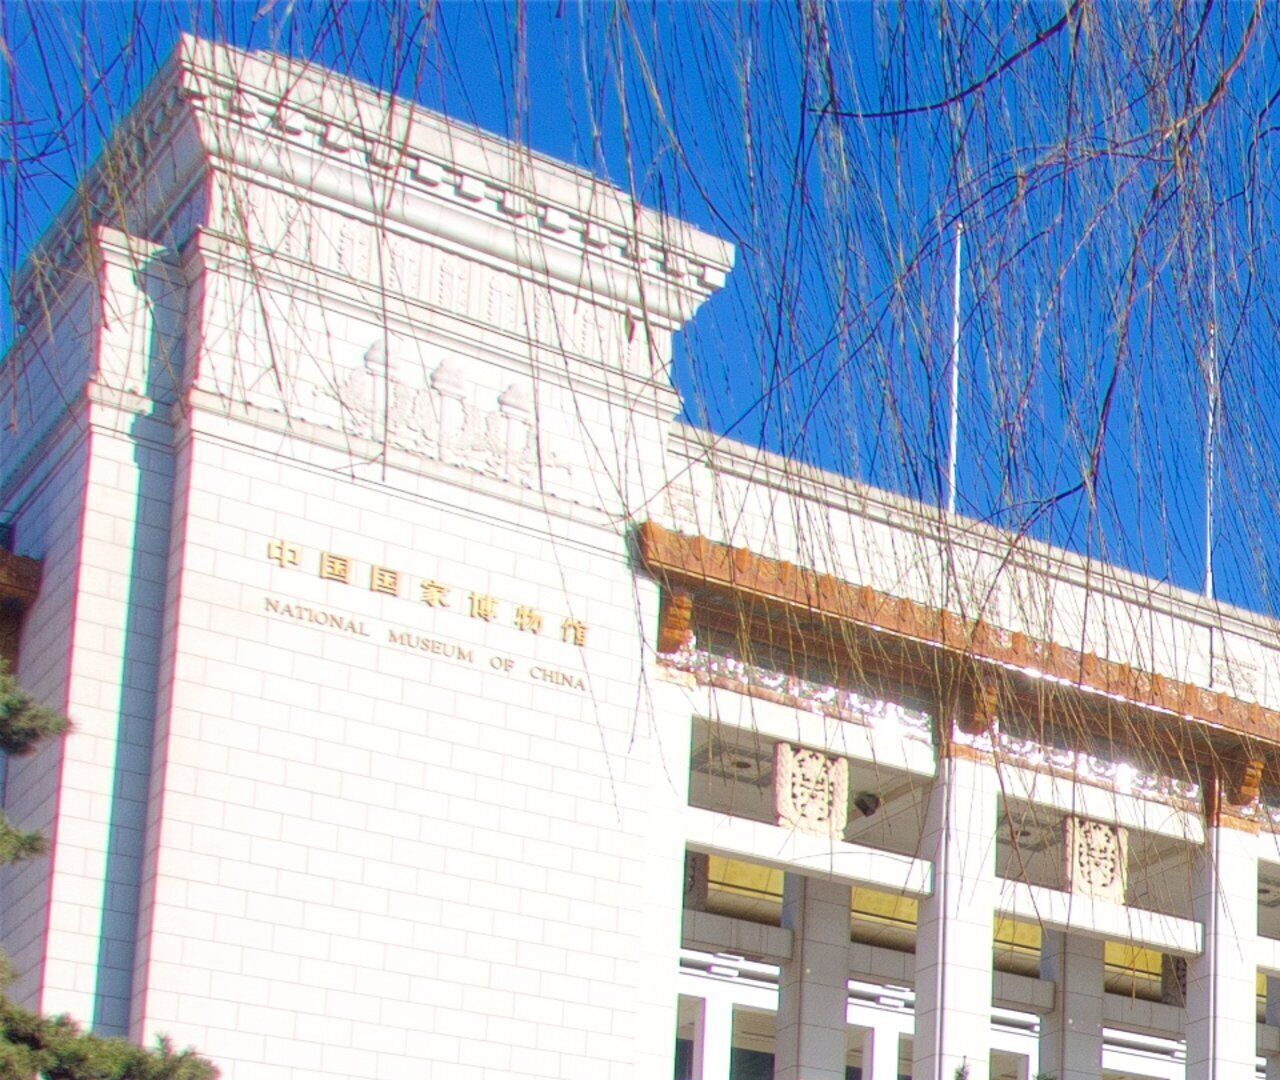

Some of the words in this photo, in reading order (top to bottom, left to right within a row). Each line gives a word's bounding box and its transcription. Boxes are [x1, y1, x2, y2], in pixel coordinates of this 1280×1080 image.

[267, 540, 588, 647] 中国国家博物馆
[264, 597, 370, 637] NATIONAL
[388, 628, 474, 663] MUSEUM
[489, 656, 516, 672] OF
[529, 666, 586, 691] CHINA
